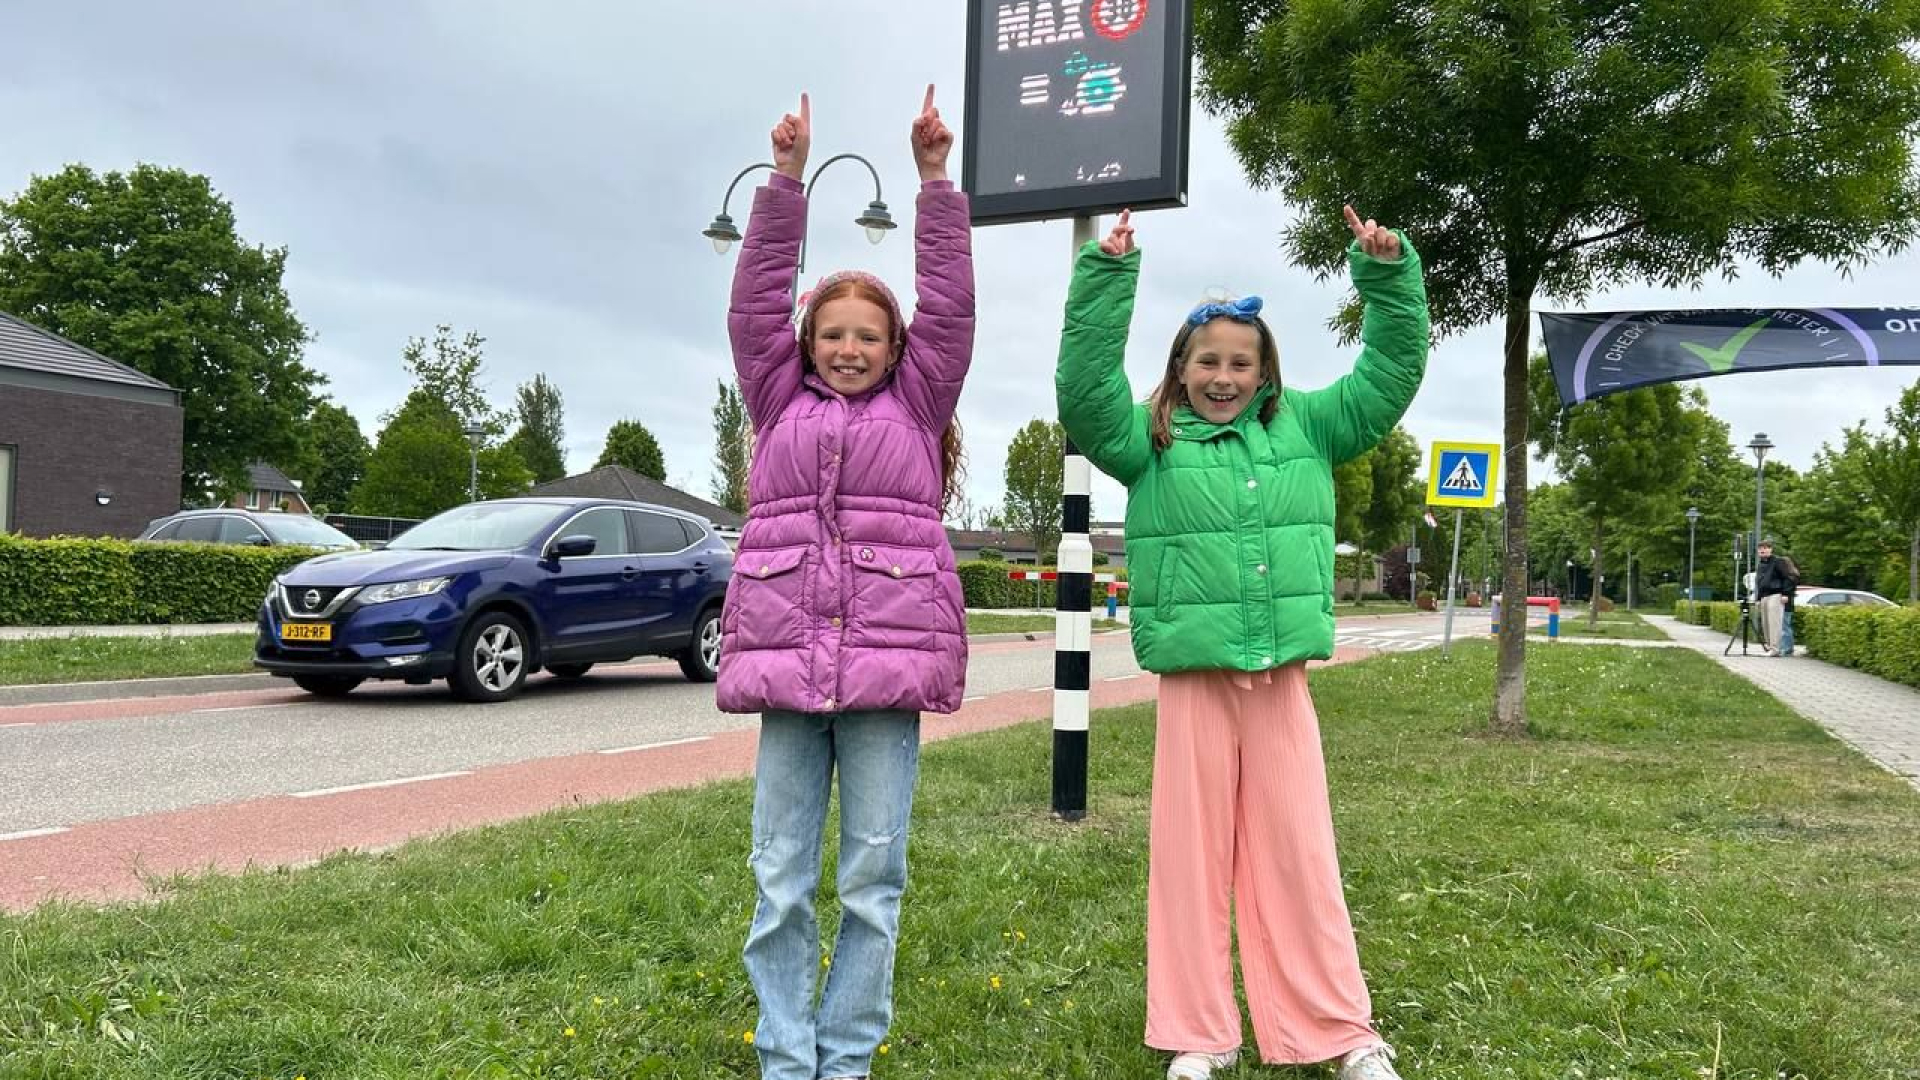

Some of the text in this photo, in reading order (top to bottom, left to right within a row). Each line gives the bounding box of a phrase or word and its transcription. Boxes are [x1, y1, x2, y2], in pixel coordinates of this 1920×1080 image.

[997, 0, 1085, 51] MAX
[1605, 323, 1645, 361] CHECK
[1772, 310, 1830, 337] METER
[285, 625, 325, 638] J-312-RF
